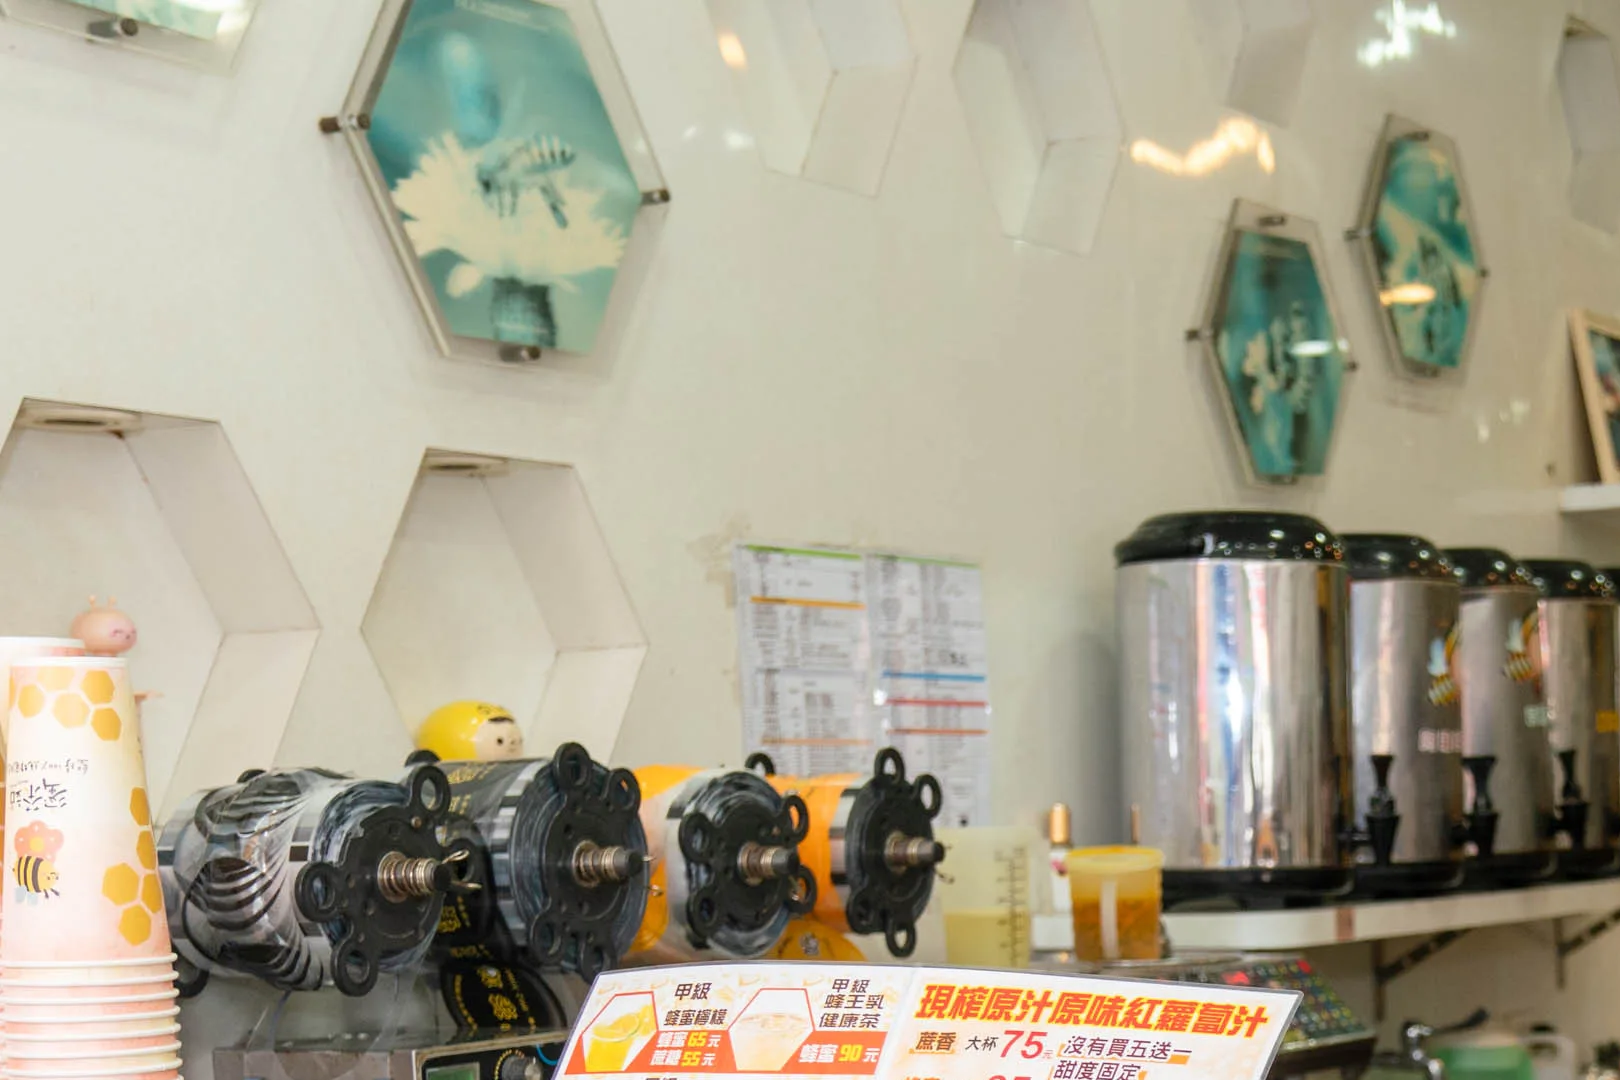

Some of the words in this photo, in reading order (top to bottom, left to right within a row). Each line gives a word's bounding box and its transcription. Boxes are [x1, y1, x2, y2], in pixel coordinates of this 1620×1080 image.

[674, 982, 713, 1000] 甲級
[831, 978, 871, 993] 甲級
[823, 993, 884, 1010] 蜂王乳
[663, 1008, 729, 1027] 蜂蜜檸檬
[818, 1012, 880, 1029] 健康茶
[914, 983, 1271, 1040] 現榨原汁原味紅蘿蔔汁
[914, 1030, 957, 1052] 蔗香
[964, 1035, 999, 1051] 大杯
[1062, 1035, 1193, 1061] 沒有買五送一
